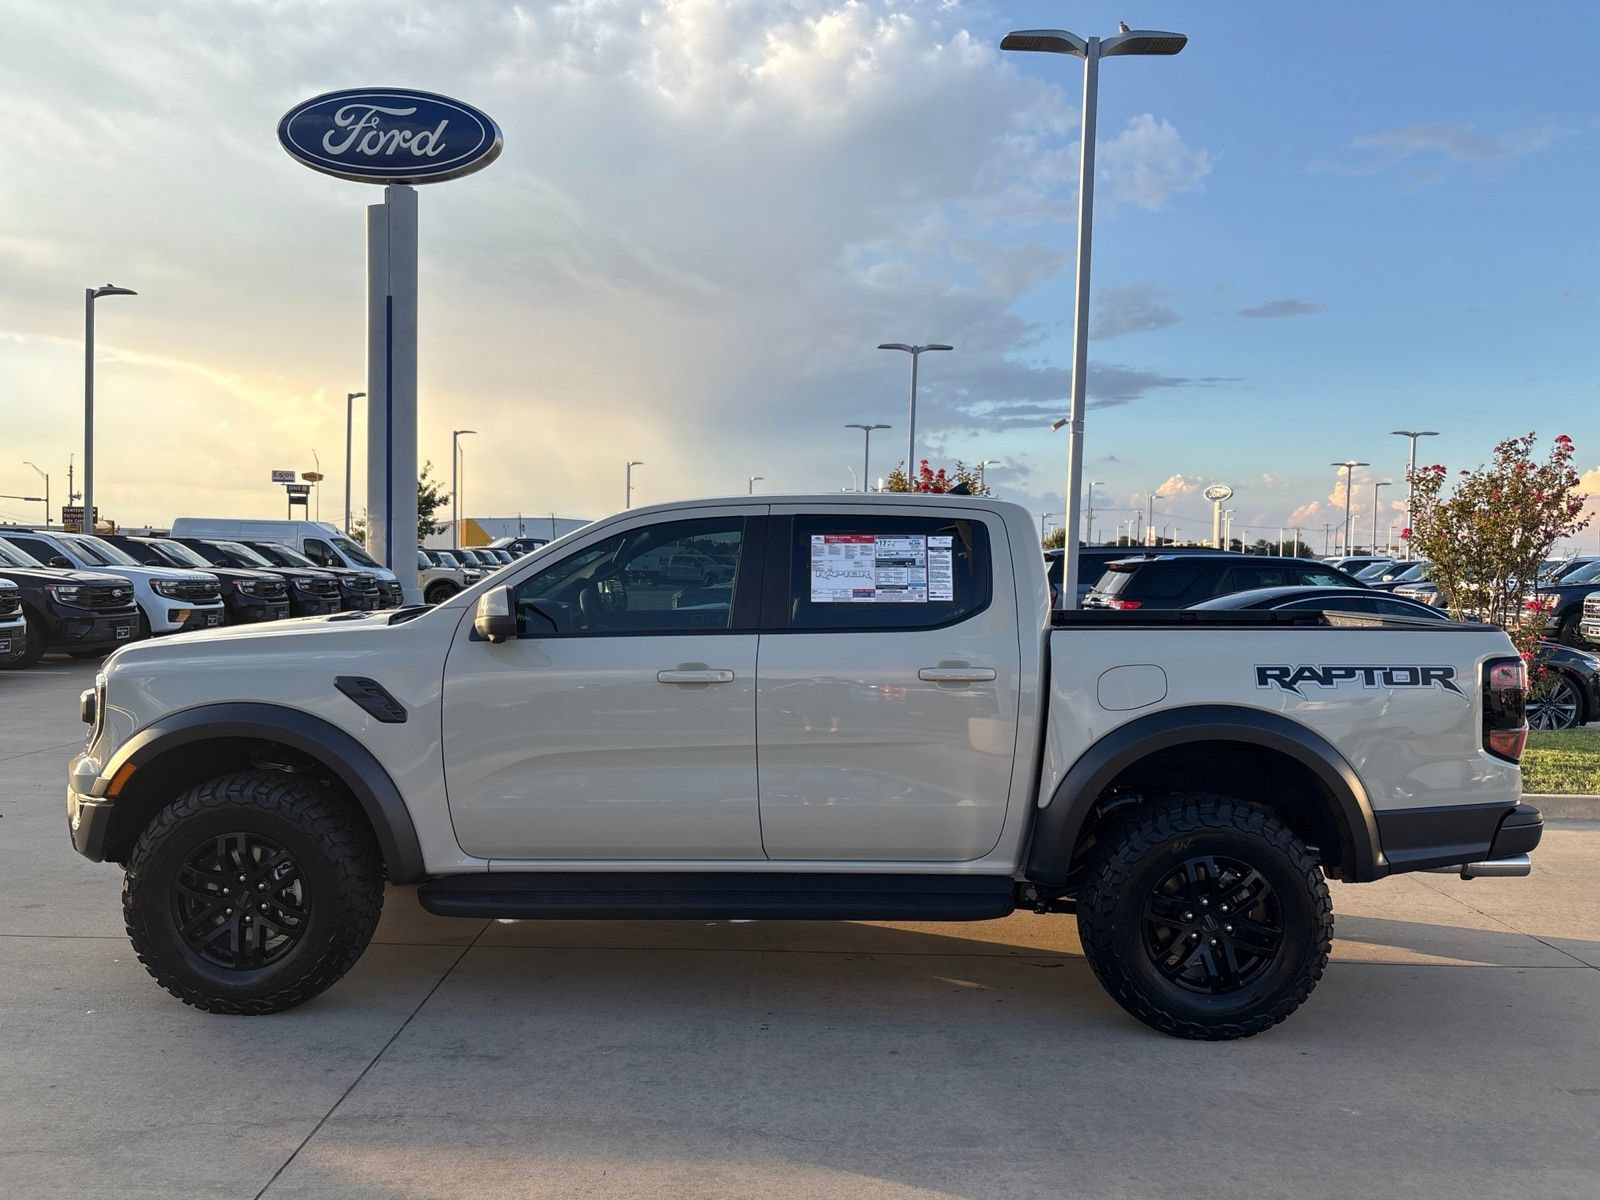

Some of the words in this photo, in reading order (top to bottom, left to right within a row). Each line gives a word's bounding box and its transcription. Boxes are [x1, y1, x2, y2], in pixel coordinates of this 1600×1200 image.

[322, 103, 449, 157] Ford
[815, 569, 873, 580] RAPTOR
[1254, 664, 1469, 700] RAPTOR
